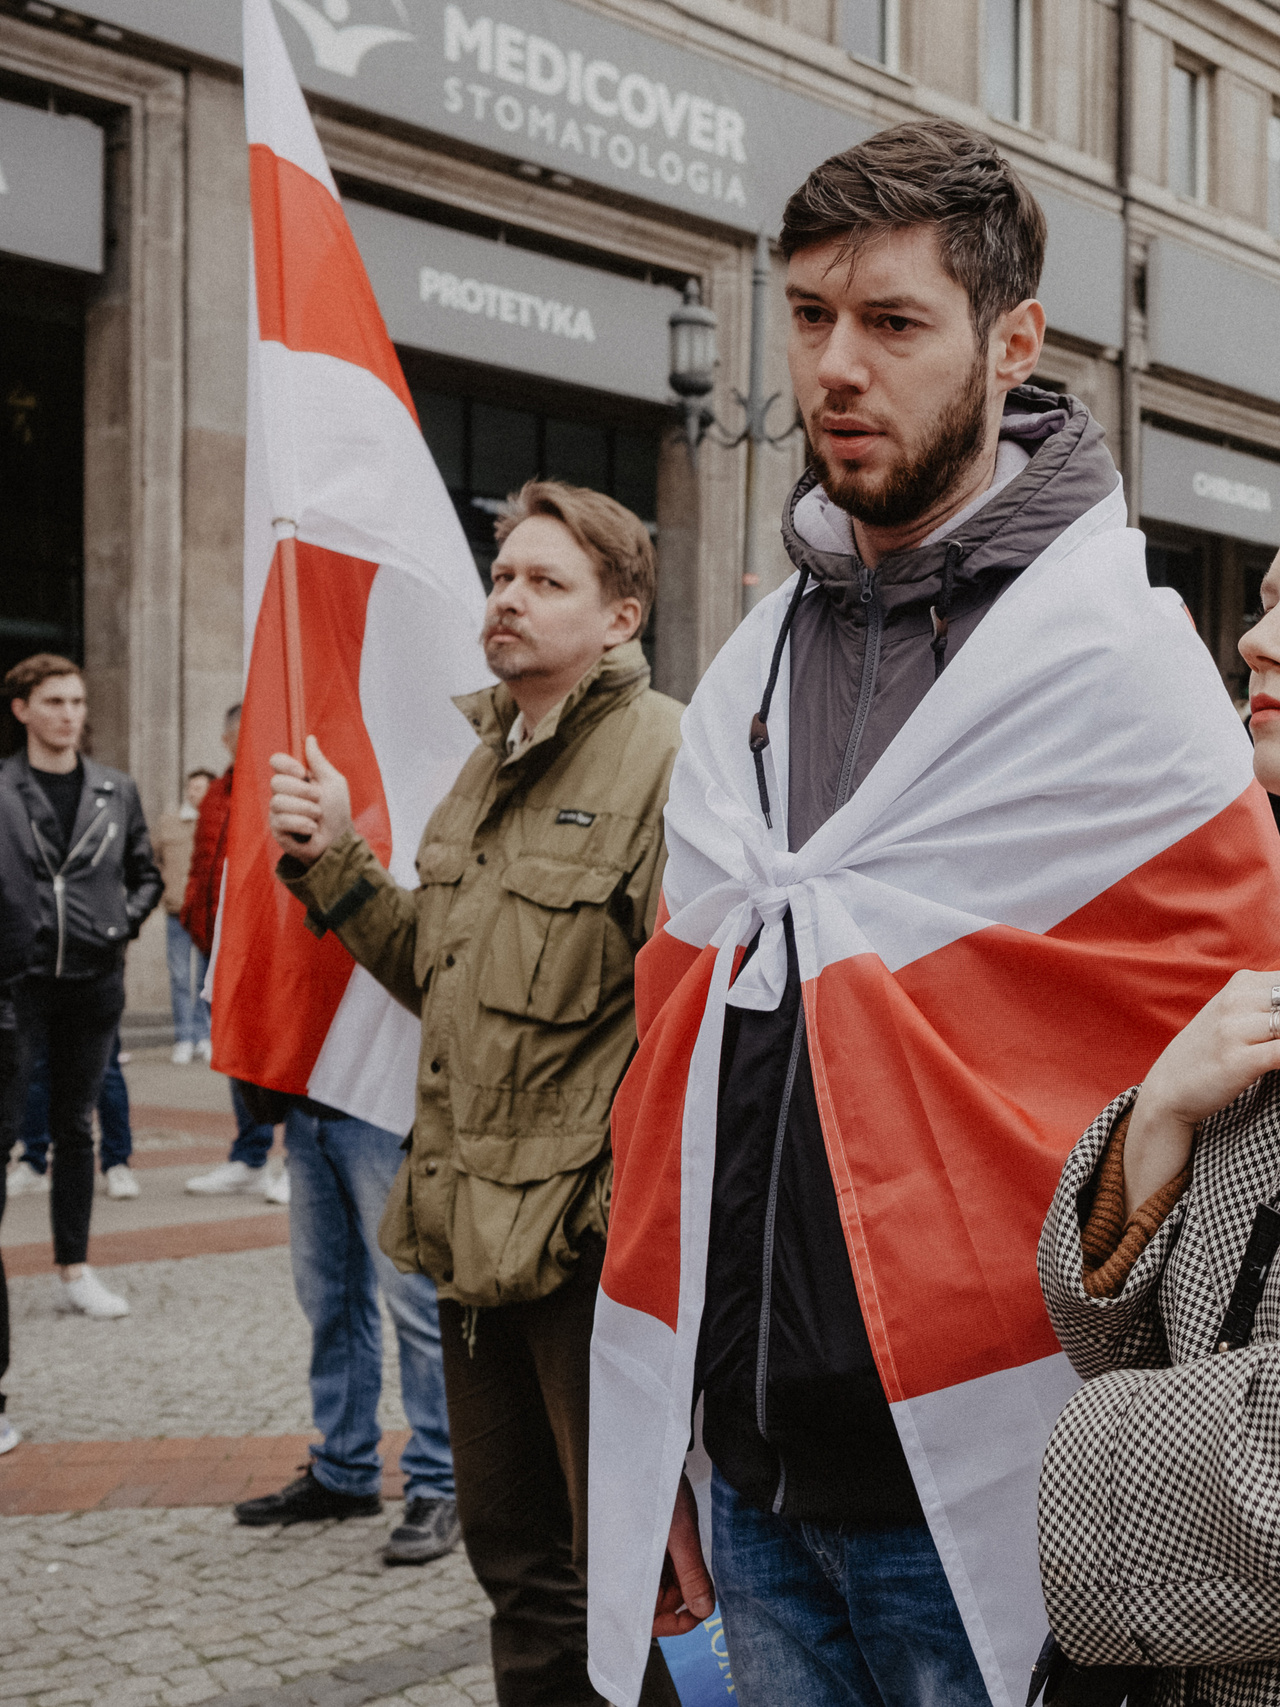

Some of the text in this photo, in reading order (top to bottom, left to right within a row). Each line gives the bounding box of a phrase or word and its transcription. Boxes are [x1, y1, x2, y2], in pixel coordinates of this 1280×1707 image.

[443, 4, 747, 164] MEDICOVER
[444, 75, 747, 208] STOMATOLOGIA
[419, 265, 597, 343] PROTETYKA
